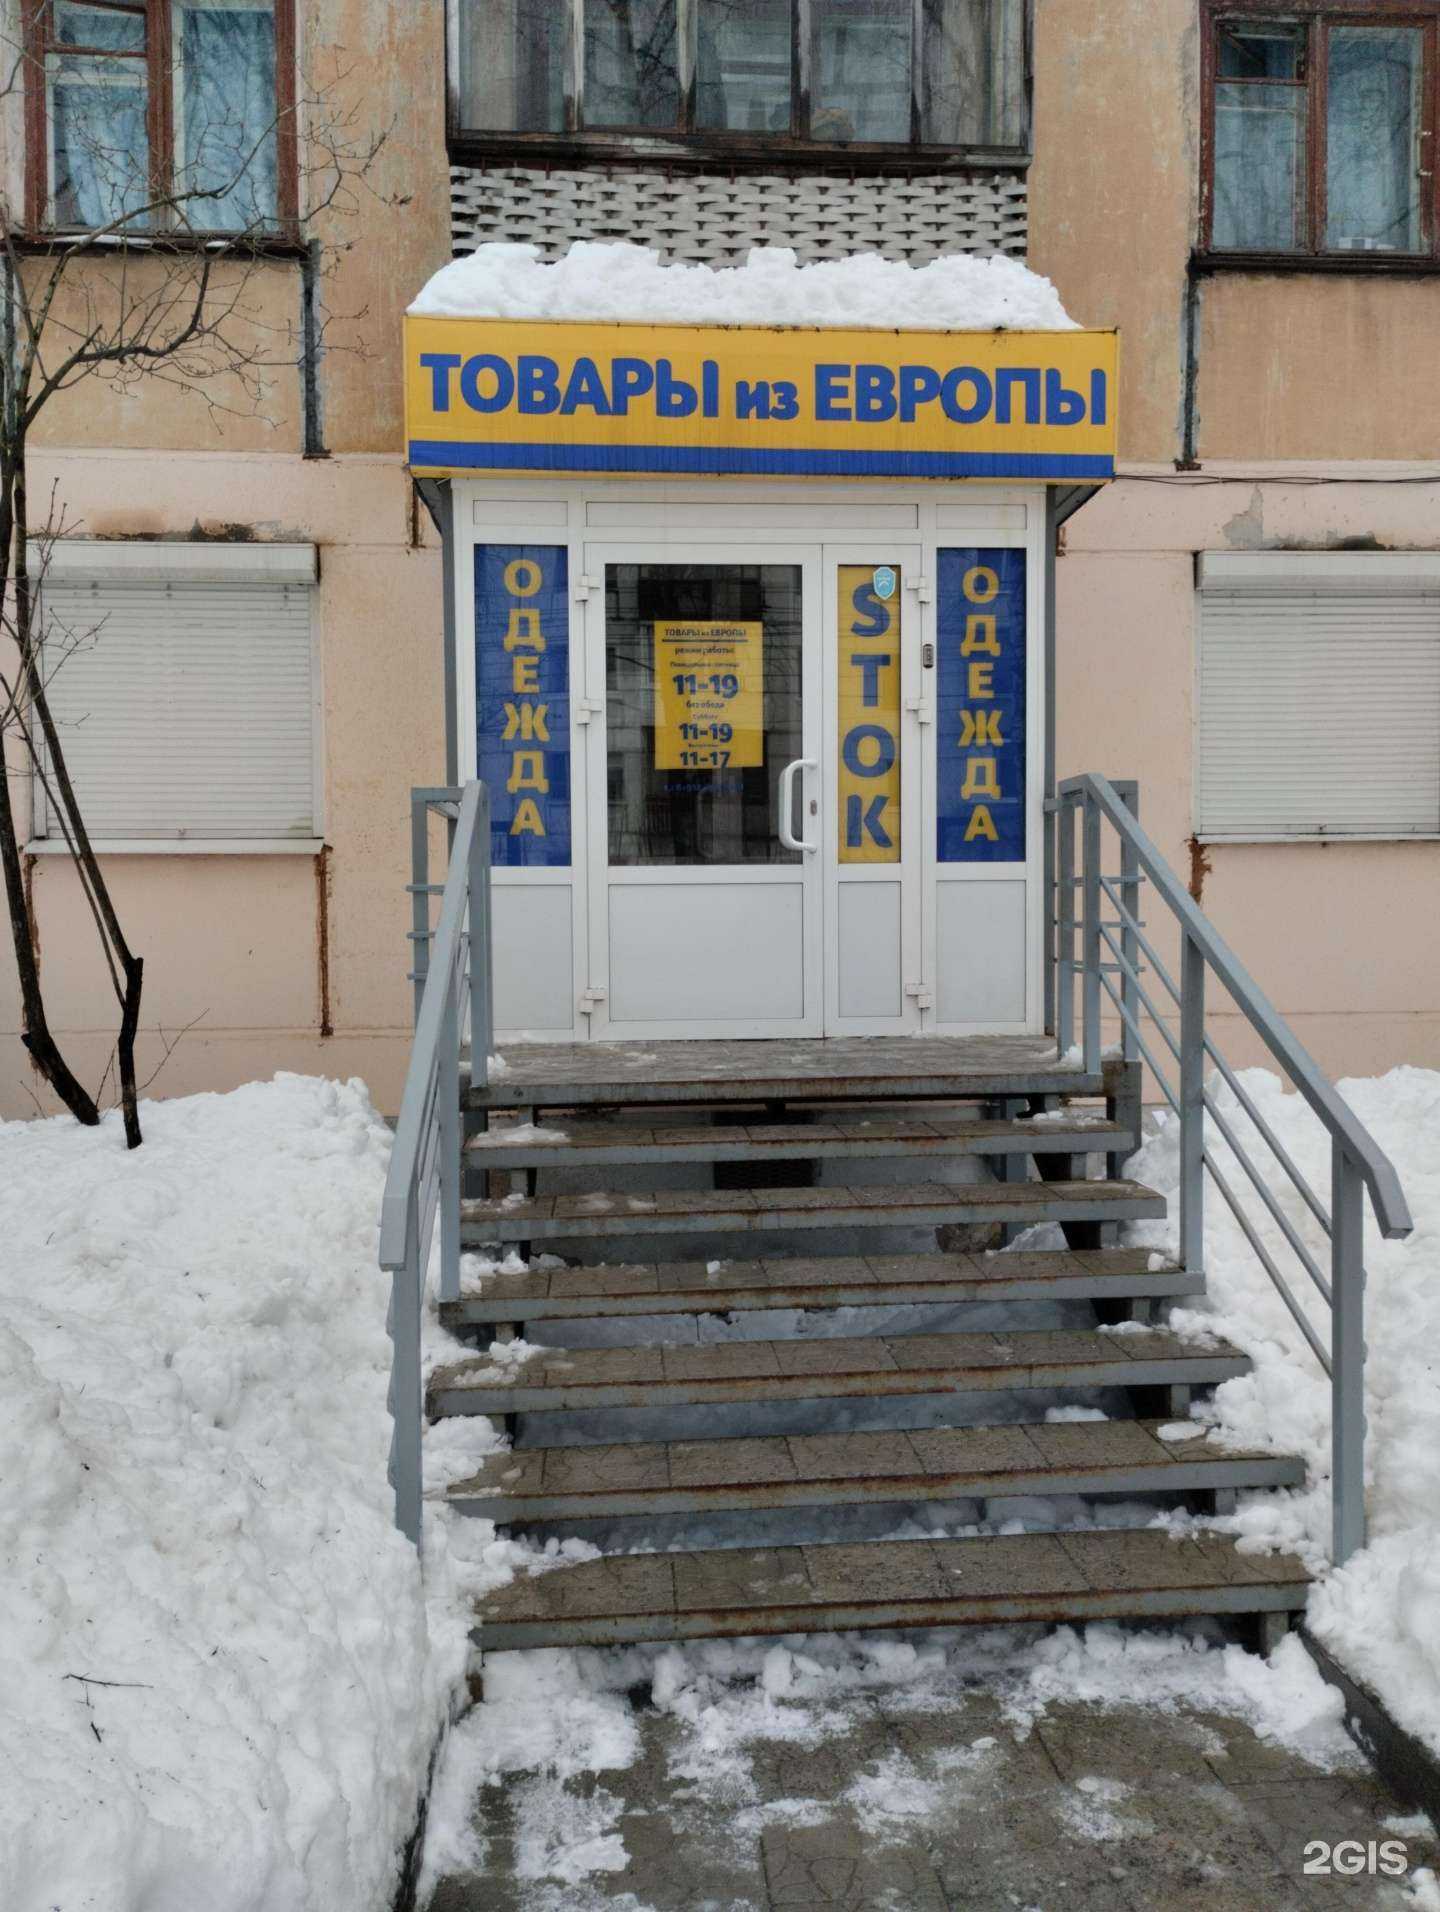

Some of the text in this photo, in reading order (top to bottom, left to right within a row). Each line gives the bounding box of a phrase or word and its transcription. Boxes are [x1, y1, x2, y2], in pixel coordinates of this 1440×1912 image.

[420, 353, 1106, 425] ТОВАРЫ из ЕВРОПЫ
[664, 628, 700, 637] ТОВАРЫ
[710, 628, 746, 637] ЕВРОПЫ
[502, 559, 550, 836] ОДЕЖДА
[672, 674, 738, 698] 11-19
[958, 566, 1004, 842] ОДЕЖДА
[678, 722, 733, 743] 11-19
[842, 582, 895, 849] STOK
[679, 751, 731, 768] 11-17
